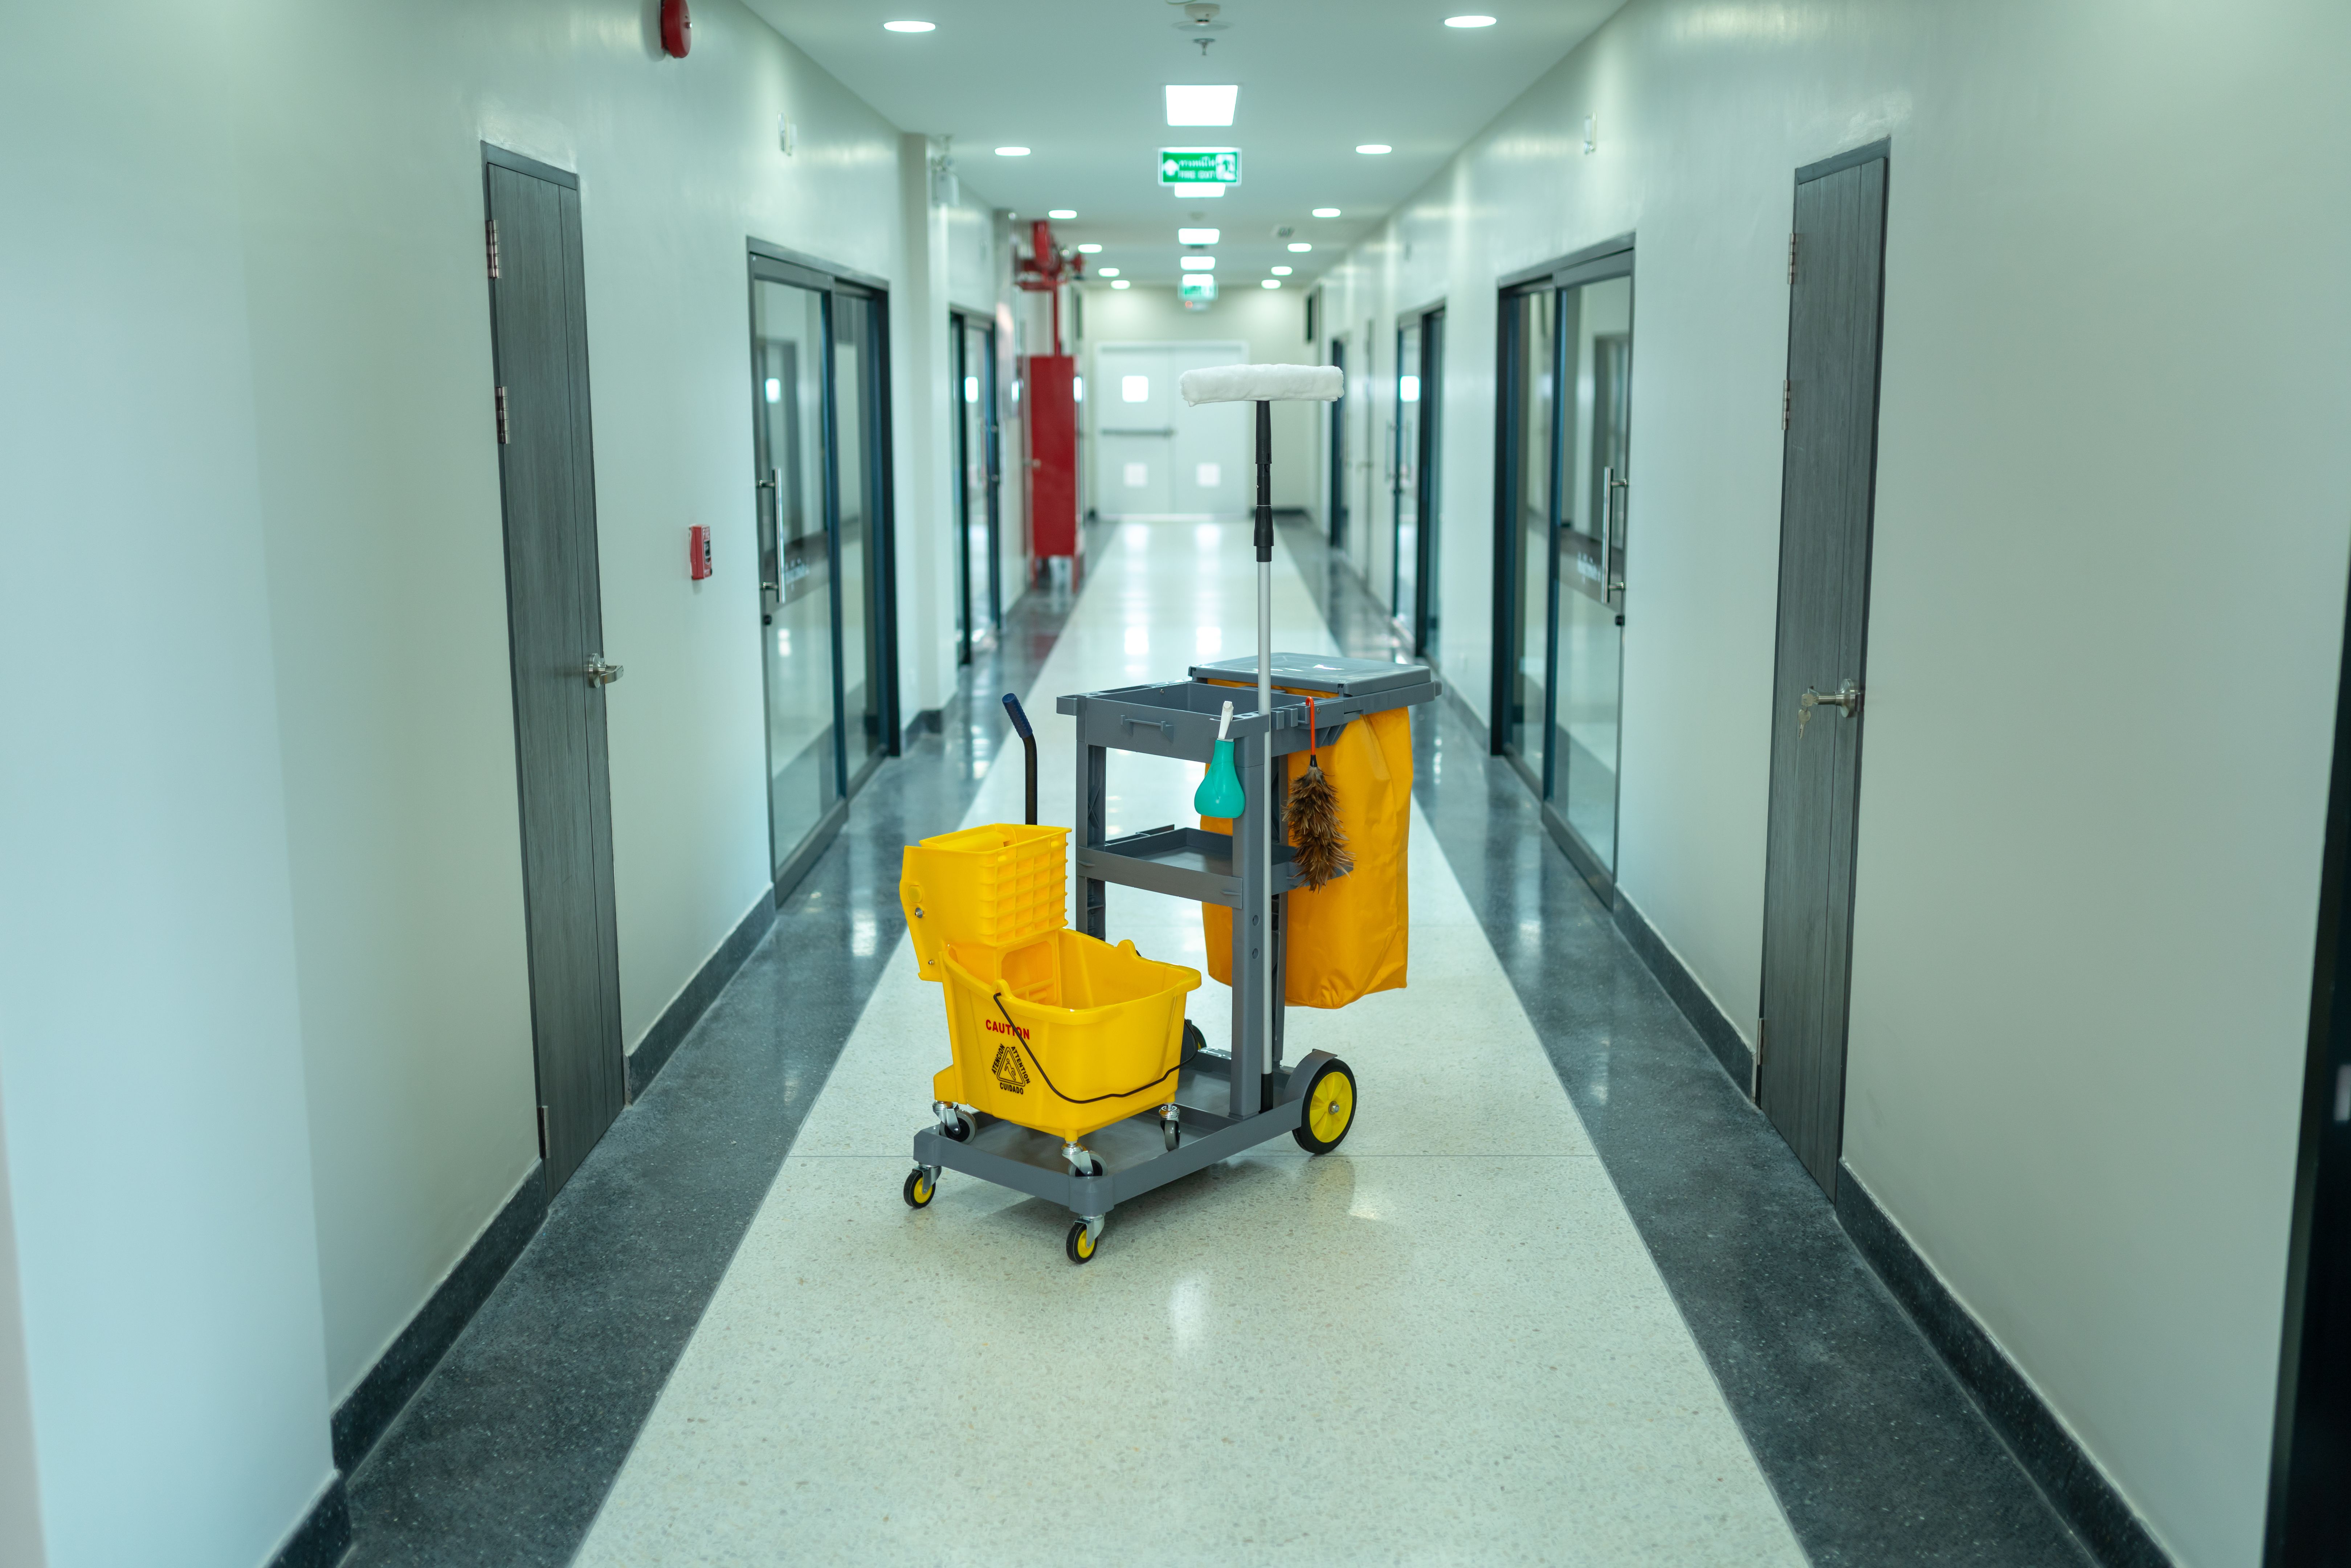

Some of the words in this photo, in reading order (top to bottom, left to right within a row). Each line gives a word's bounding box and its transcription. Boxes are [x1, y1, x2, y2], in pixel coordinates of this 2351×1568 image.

[991, 1043, 1005, 1075] ATENCION
[1011, 1046, 1030, 1084] ATTENTION
[1000, 1082, 1024, 1095] CUIDADO
